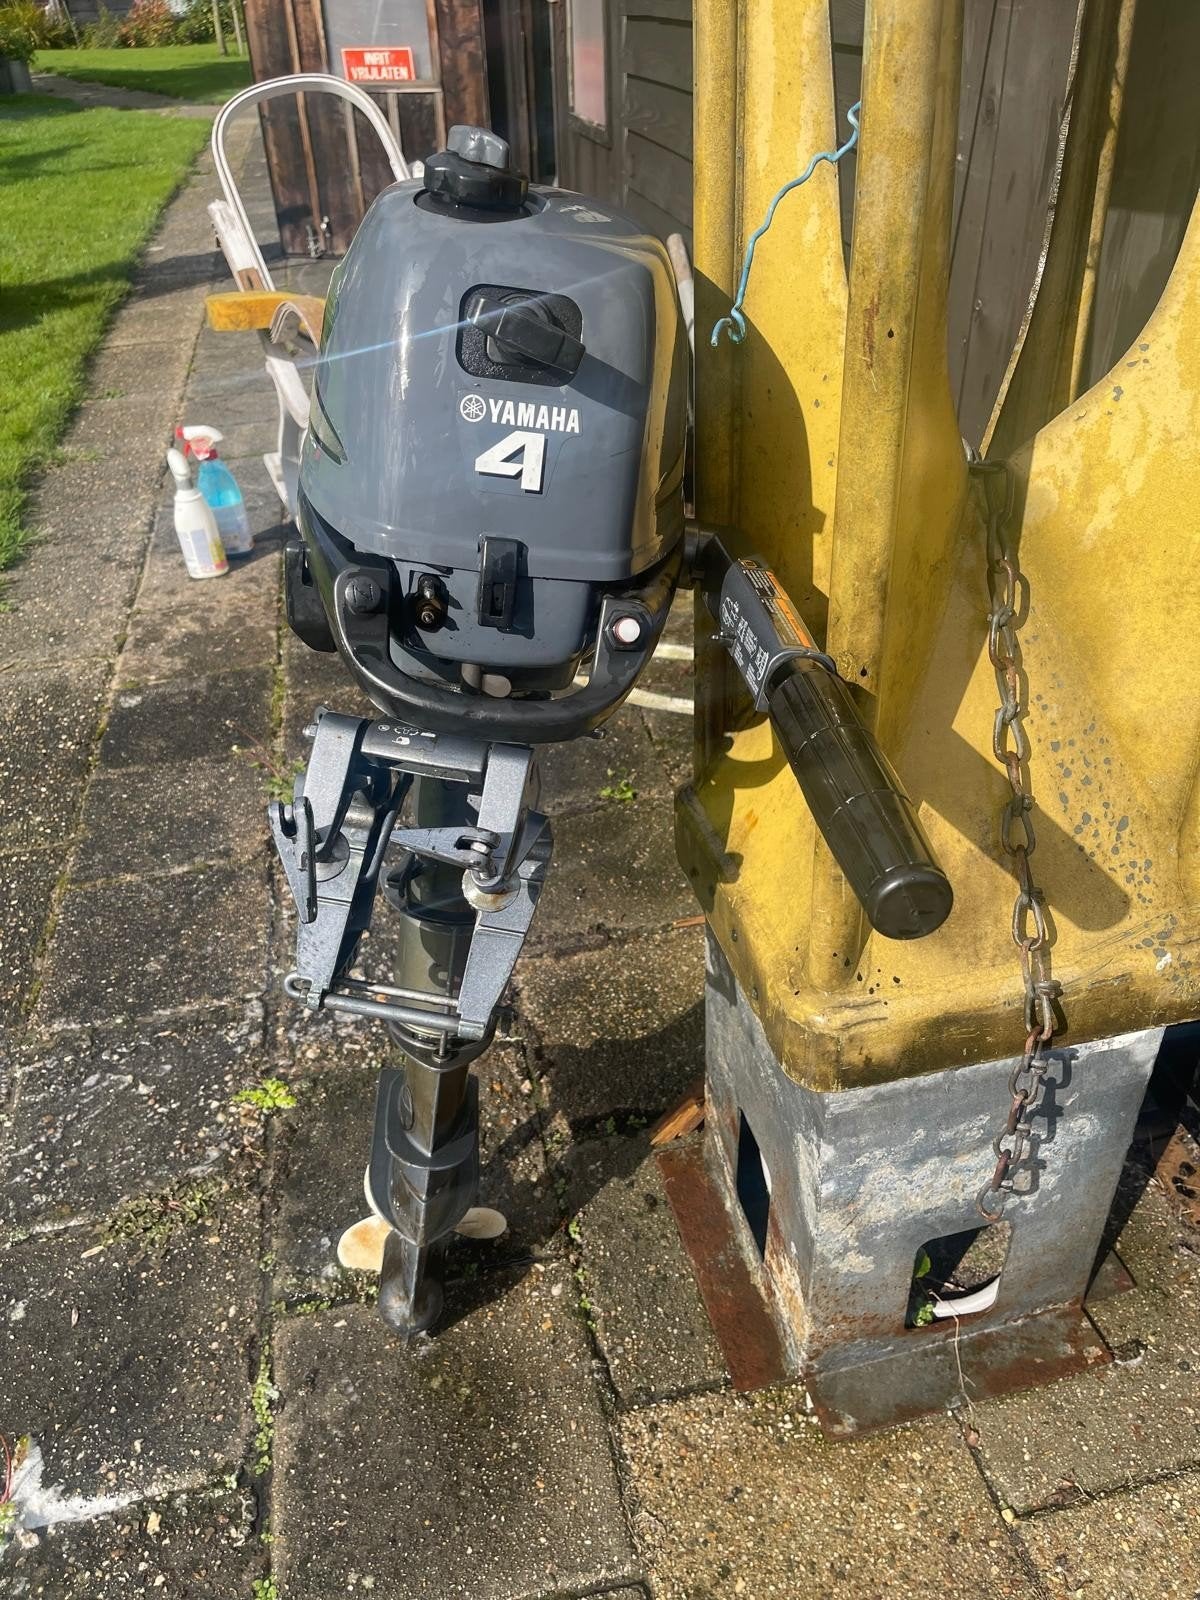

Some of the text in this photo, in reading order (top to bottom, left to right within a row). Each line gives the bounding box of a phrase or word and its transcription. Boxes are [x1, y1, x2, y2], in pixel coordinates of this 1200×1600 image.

[350, 65, 409, 81] VRIJLATEN
[488, 398, 580, 433] YAMAHA
[474, 430, 546, 492] 4
